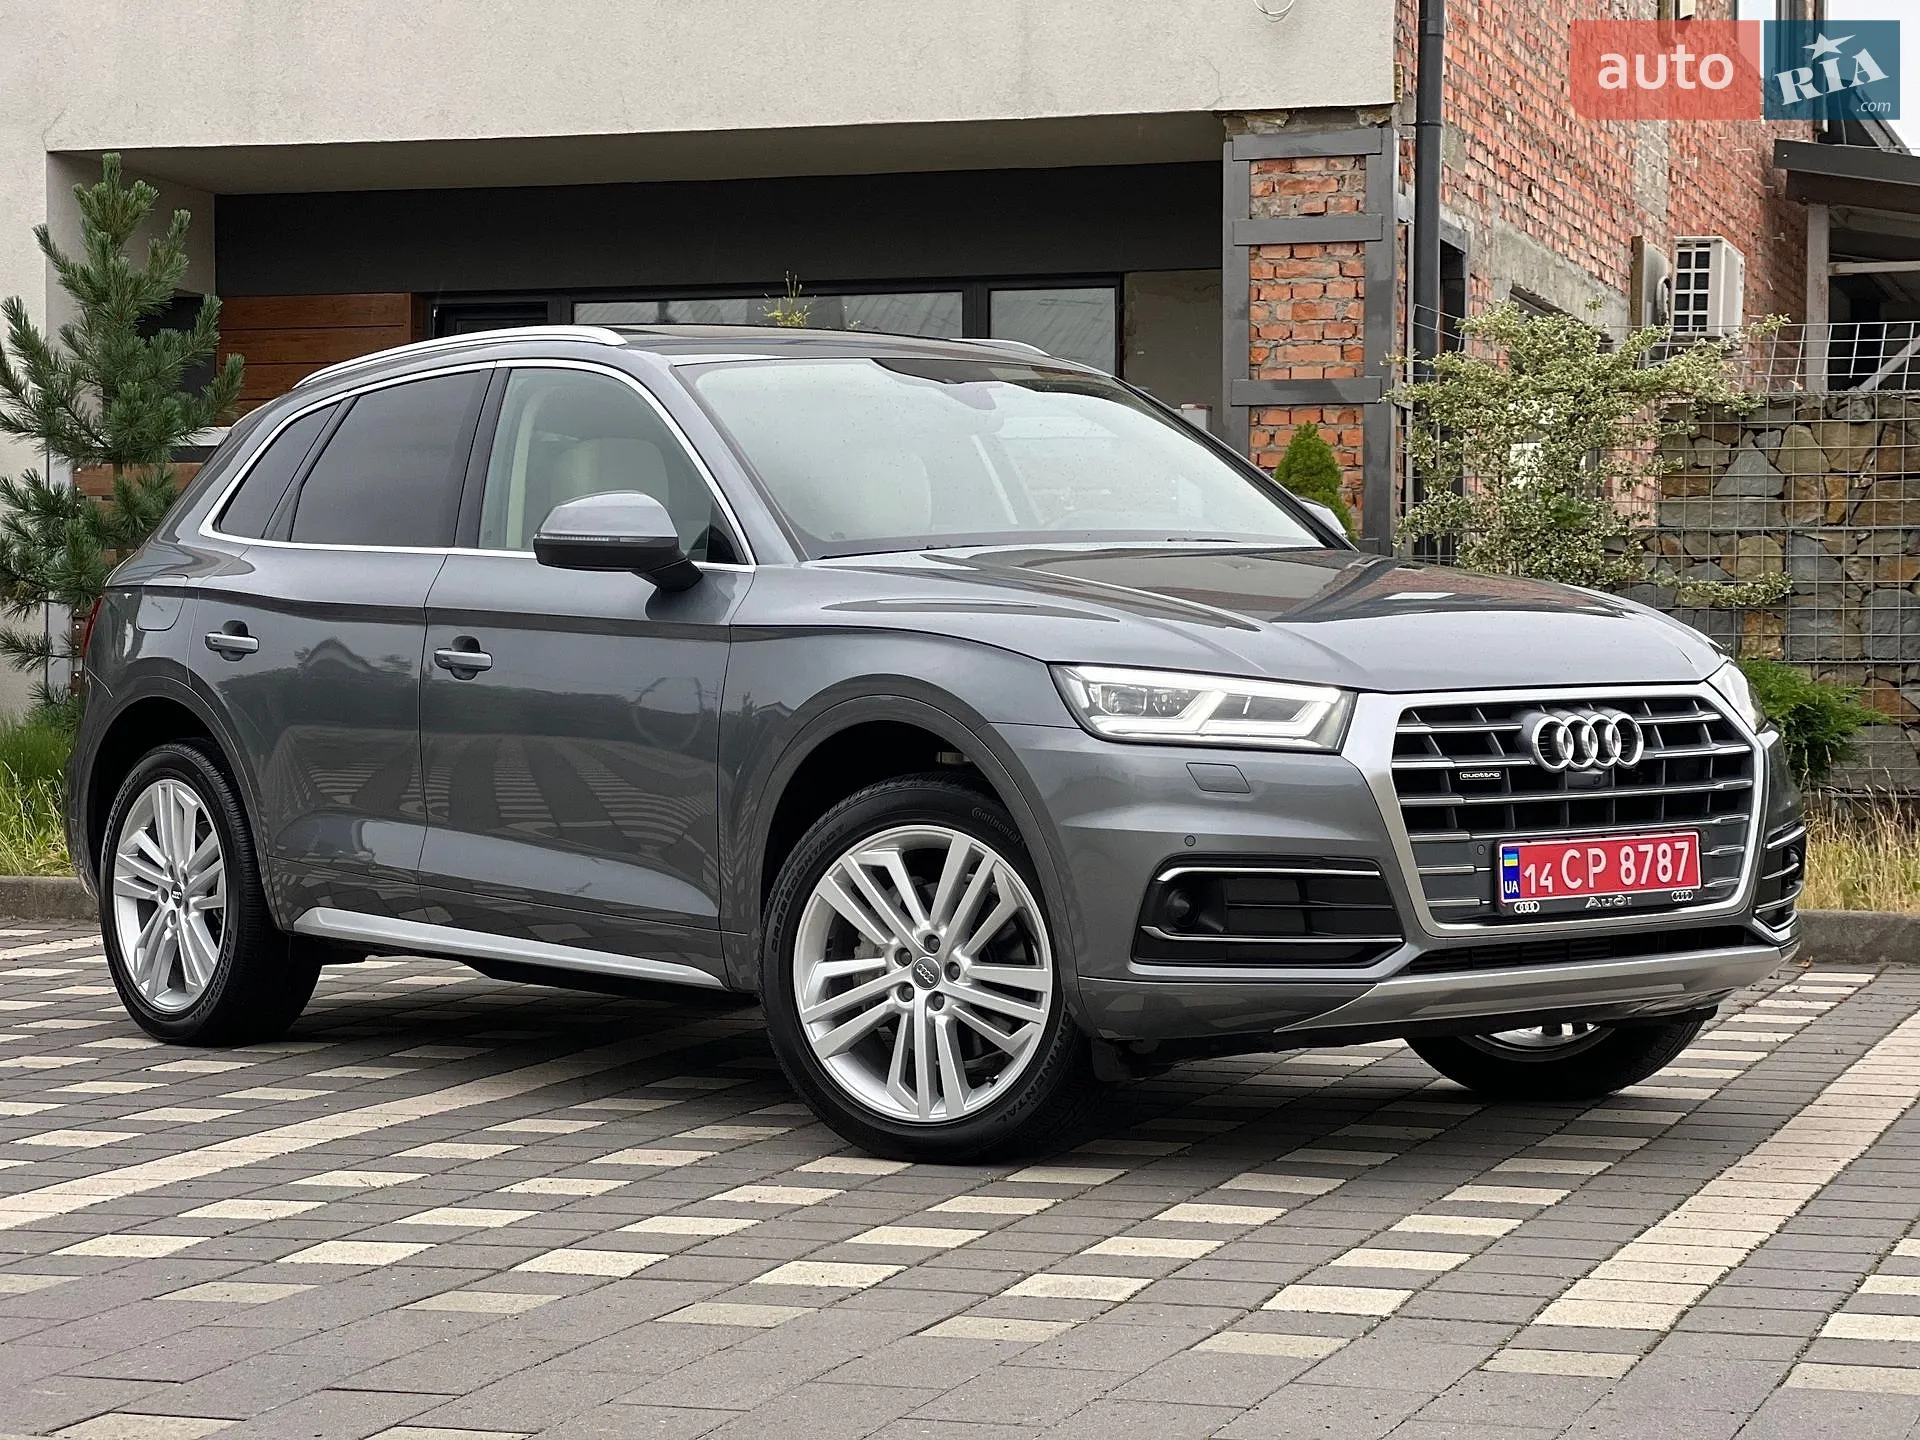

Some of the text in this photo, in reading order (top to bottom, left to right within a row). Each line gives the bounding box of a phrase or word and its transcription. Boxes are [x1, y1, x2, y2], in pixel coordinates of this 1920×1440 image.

[1523, 841, 1689, 894] 14 CP 8787
[1504, 880, 1519, 894] UA
